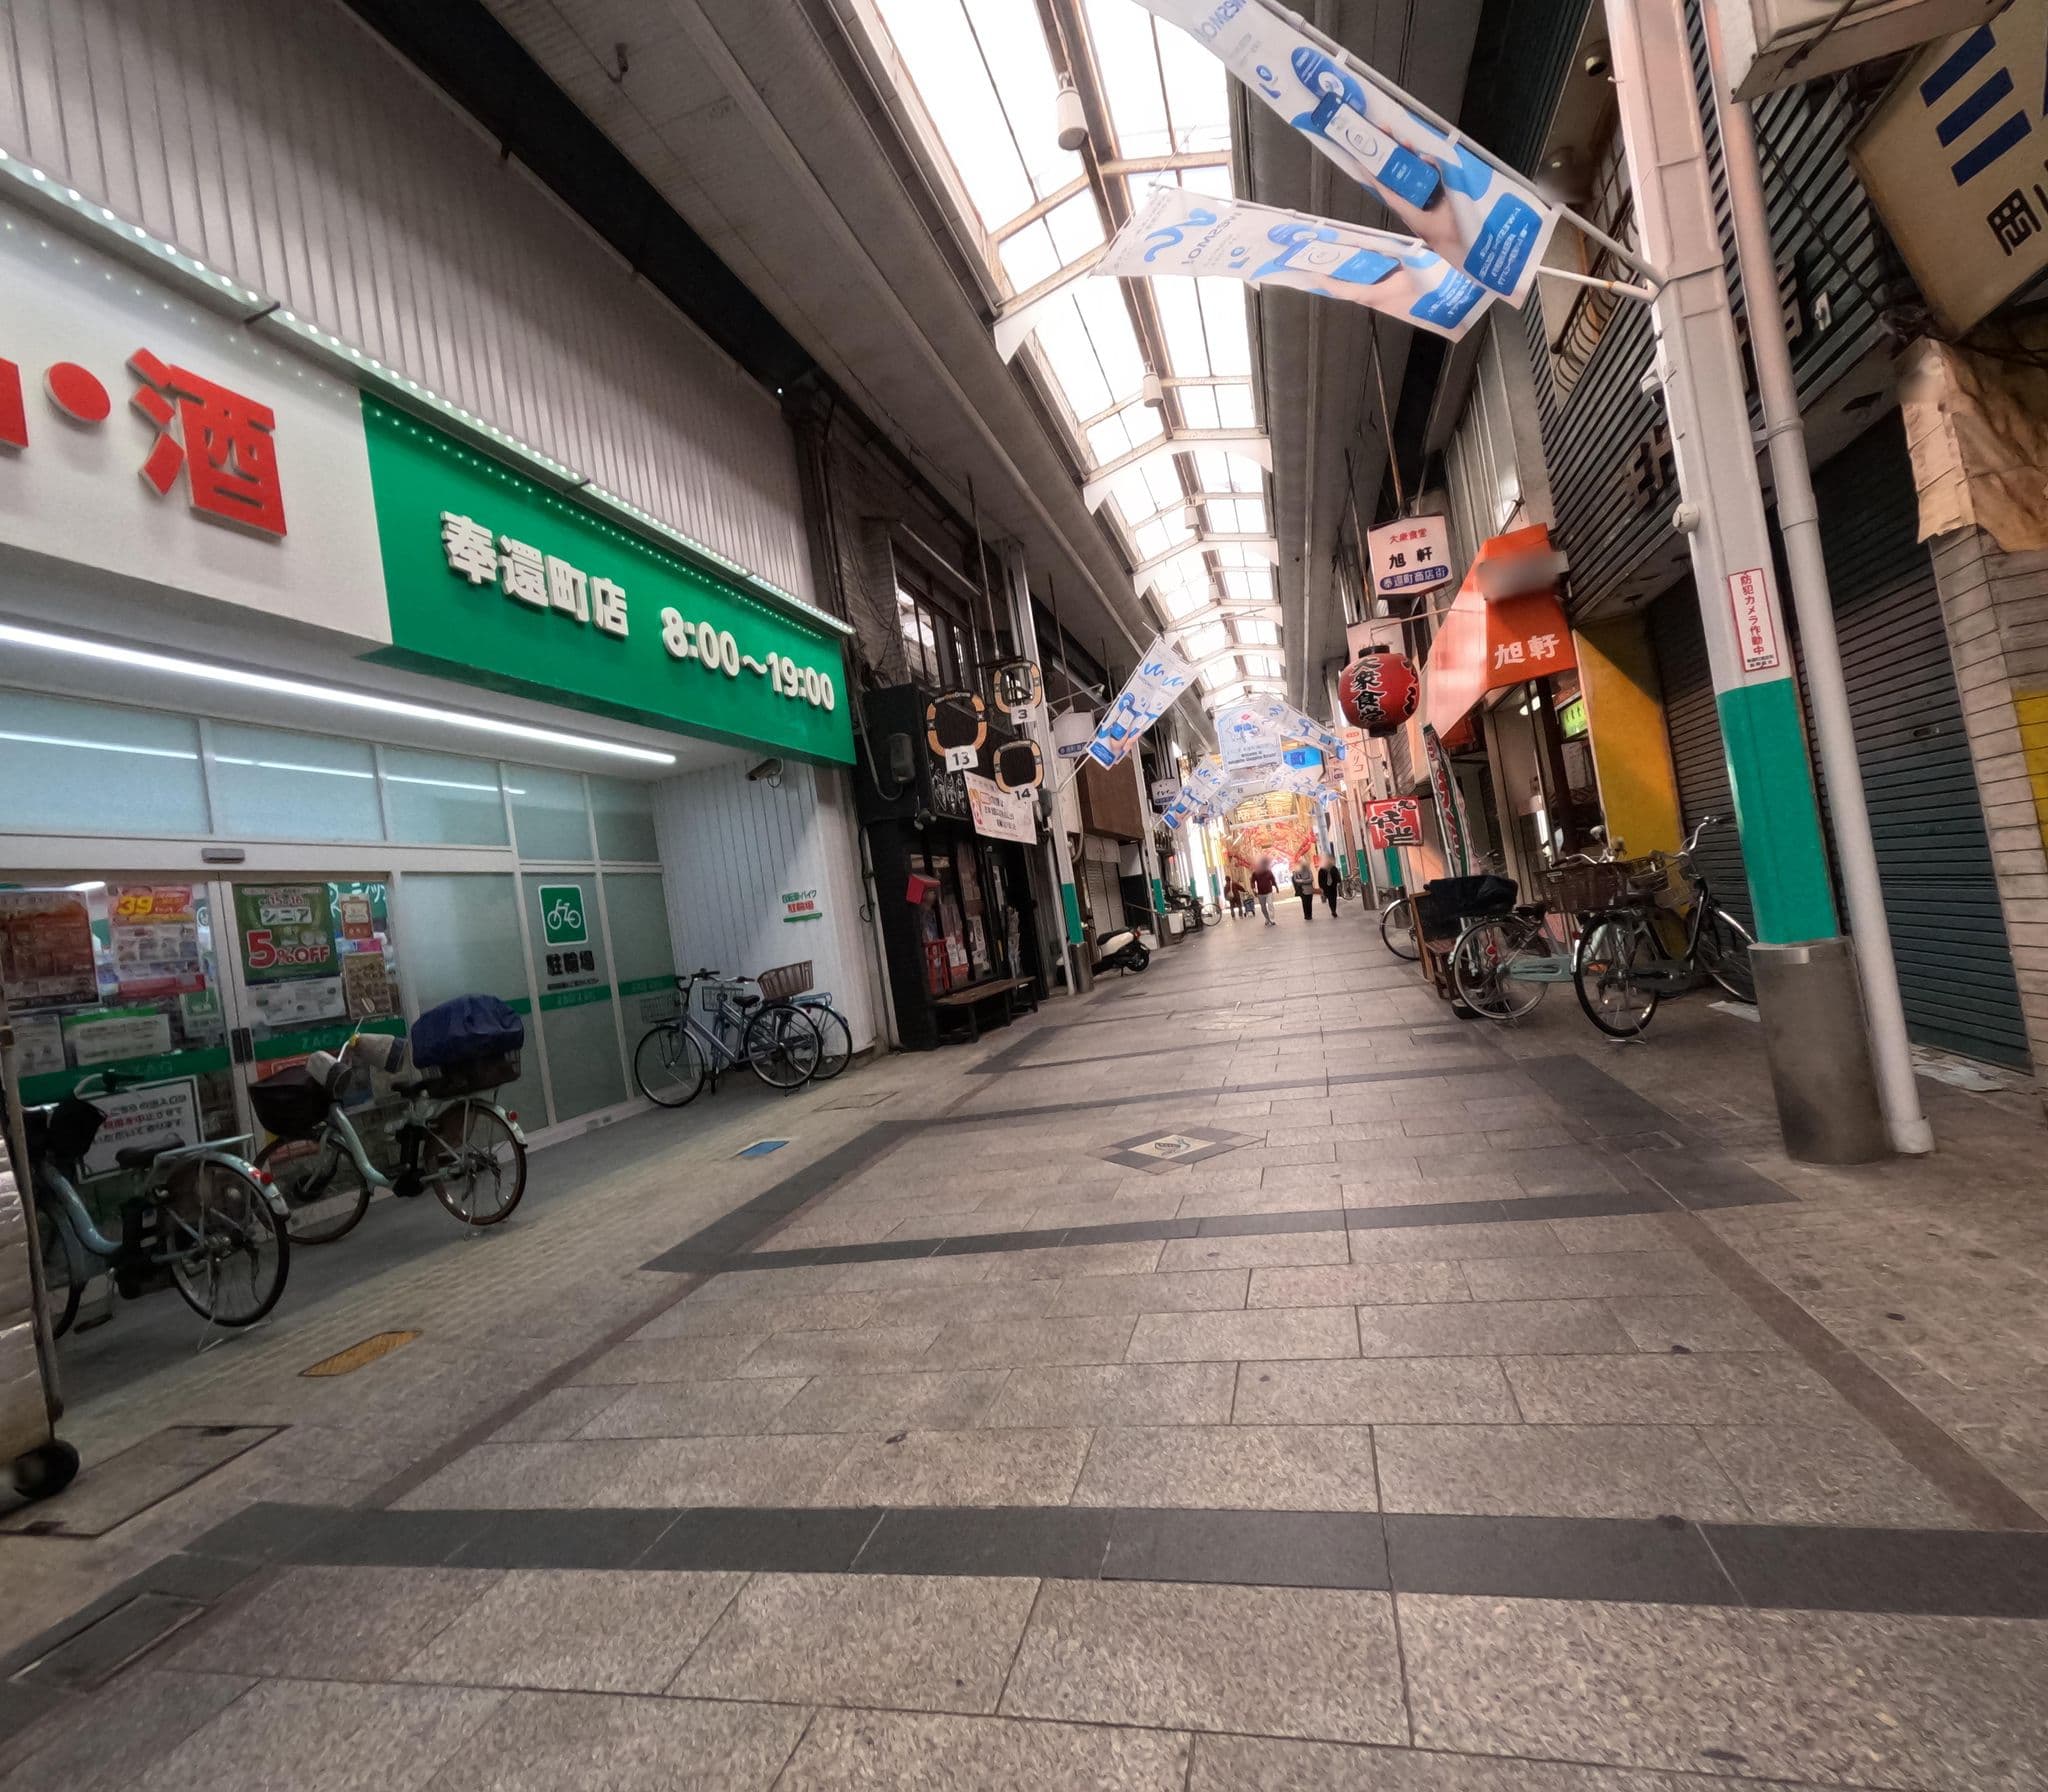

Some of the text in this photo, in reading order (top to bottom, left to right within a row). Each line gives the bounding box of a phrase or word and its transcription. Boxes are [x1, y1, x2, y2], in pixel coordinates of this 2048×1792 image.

[440, 511, 629, 638] 奉還町店
[1740, 574, 1765, 655] 防犯カメラ作動中
[1494, 633, 1560, 670] 旭軒
[1018, 709, 1028, 719] 3
[951, 752, 970, 767] 13
[1015, 790, 1032, 800] 14
[262, 907, 311, 925] シニア
[246, 929, 331, 969] 5%OFF
